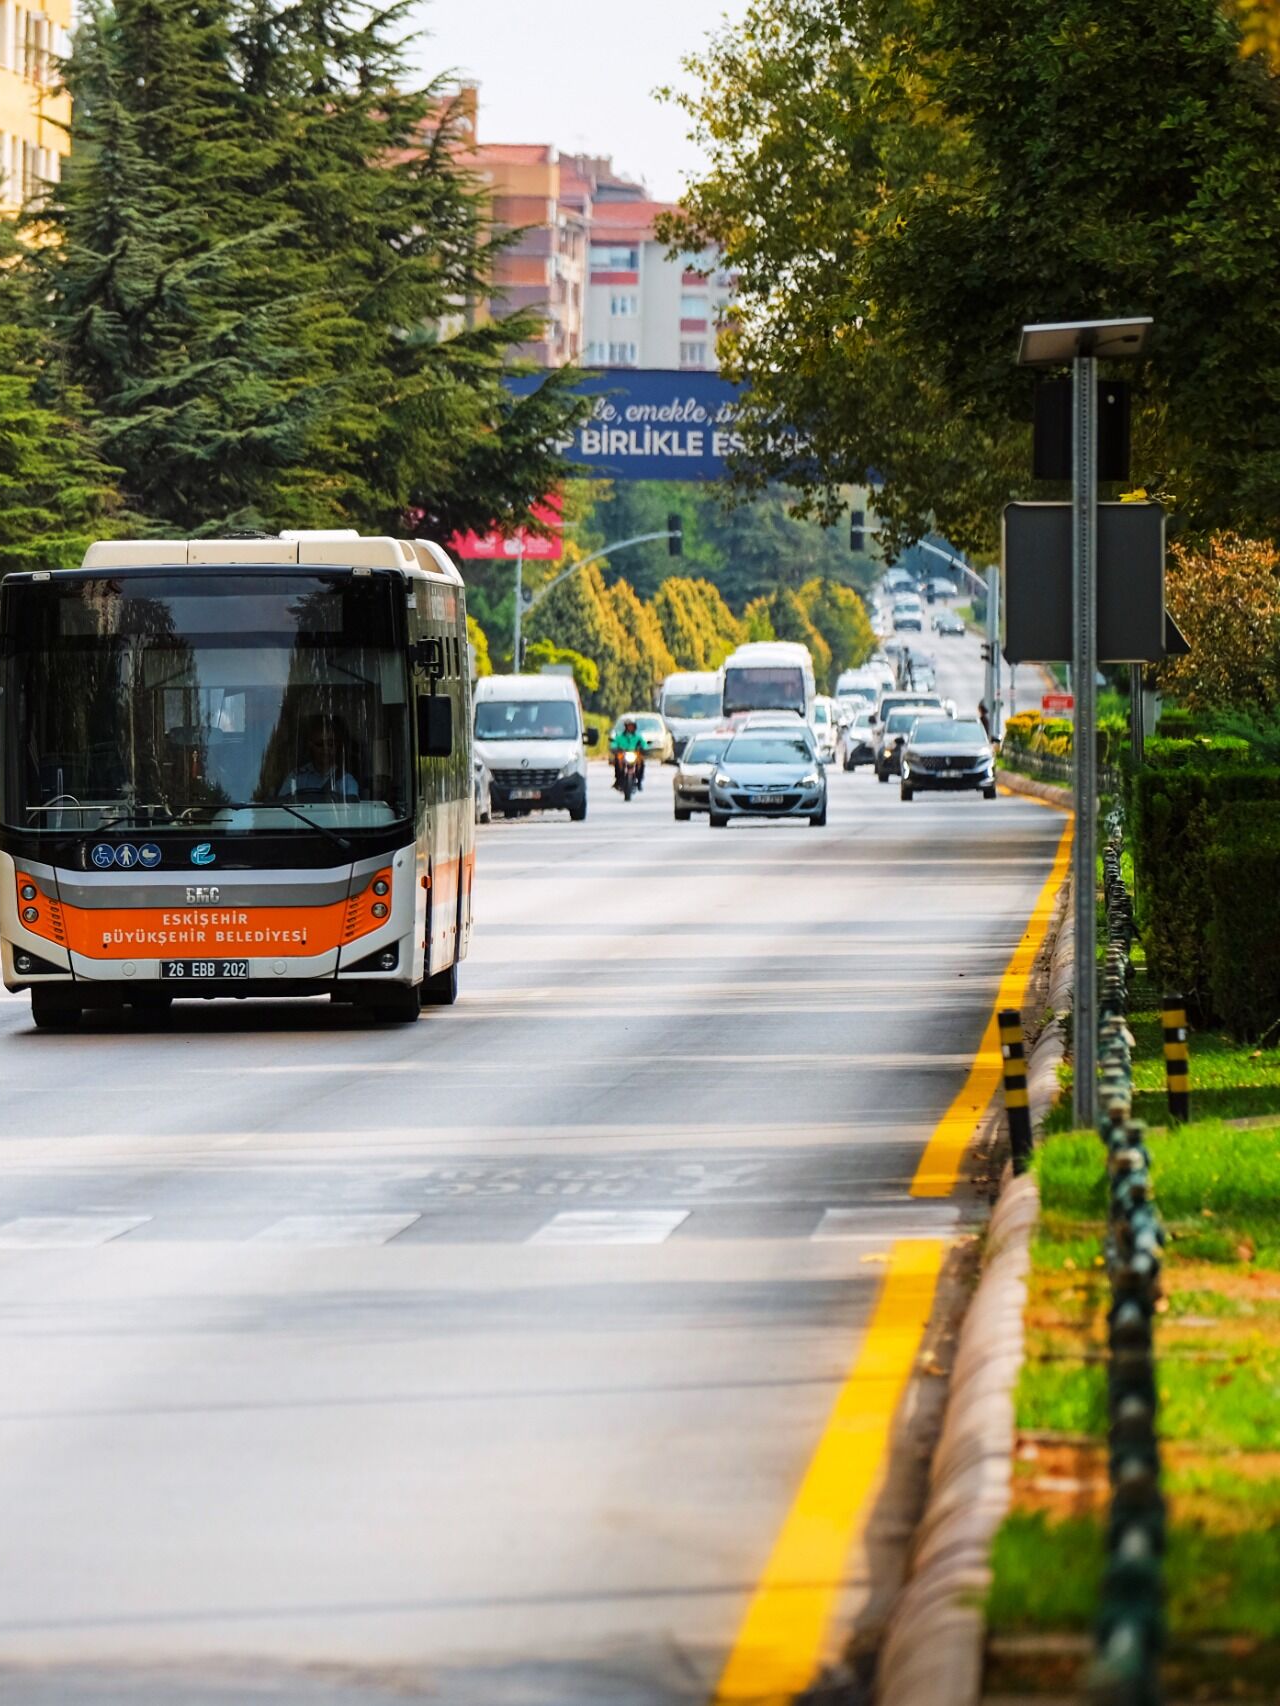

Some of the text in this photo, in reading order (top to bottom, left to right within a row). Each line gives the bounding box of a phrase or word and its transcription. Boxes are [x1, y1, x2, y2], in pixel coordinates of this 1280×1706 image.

[581, 424, 703, 456] BİRLİKLE
[186, 887, 219, 903] BMC
[163, 911, 248, 927] ESKİŞEHİR
[103, 928, 307, 946] BÜYÜKŞEHİR BELEDİYESİ
[168, 963, 246, 977] 26 EBB 202
